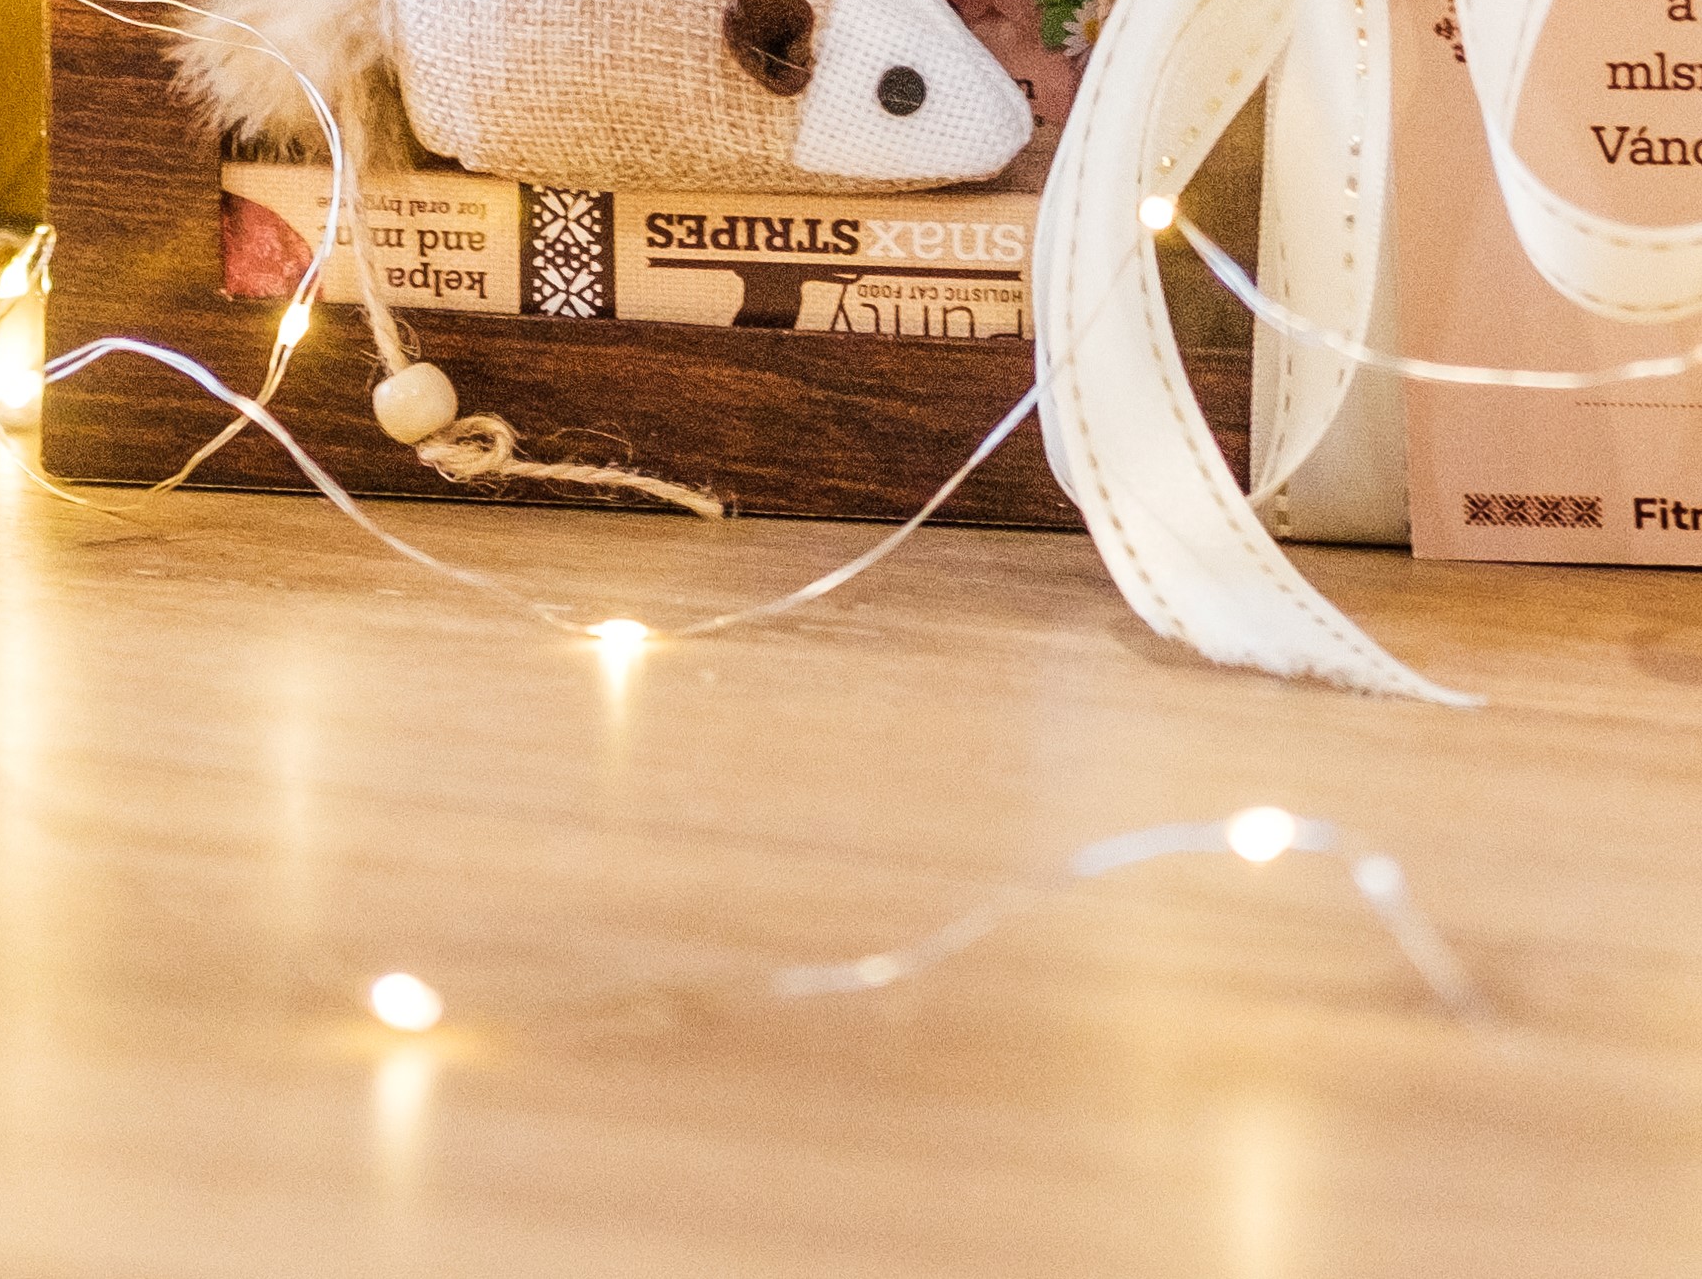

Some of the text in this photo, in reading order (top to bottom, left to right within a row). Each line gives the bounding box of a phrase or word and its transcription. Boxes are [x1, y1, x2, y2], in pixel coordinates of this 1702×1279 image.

[409, 199, 450, 217] oral
[417, 229, 486, 257] and
[645, 213, 1025, 262] snax STRIPES
[385, 263, 488, 299] kelpa
[857, 284, 1023, 303] HOLISTIC CAT FOOD
